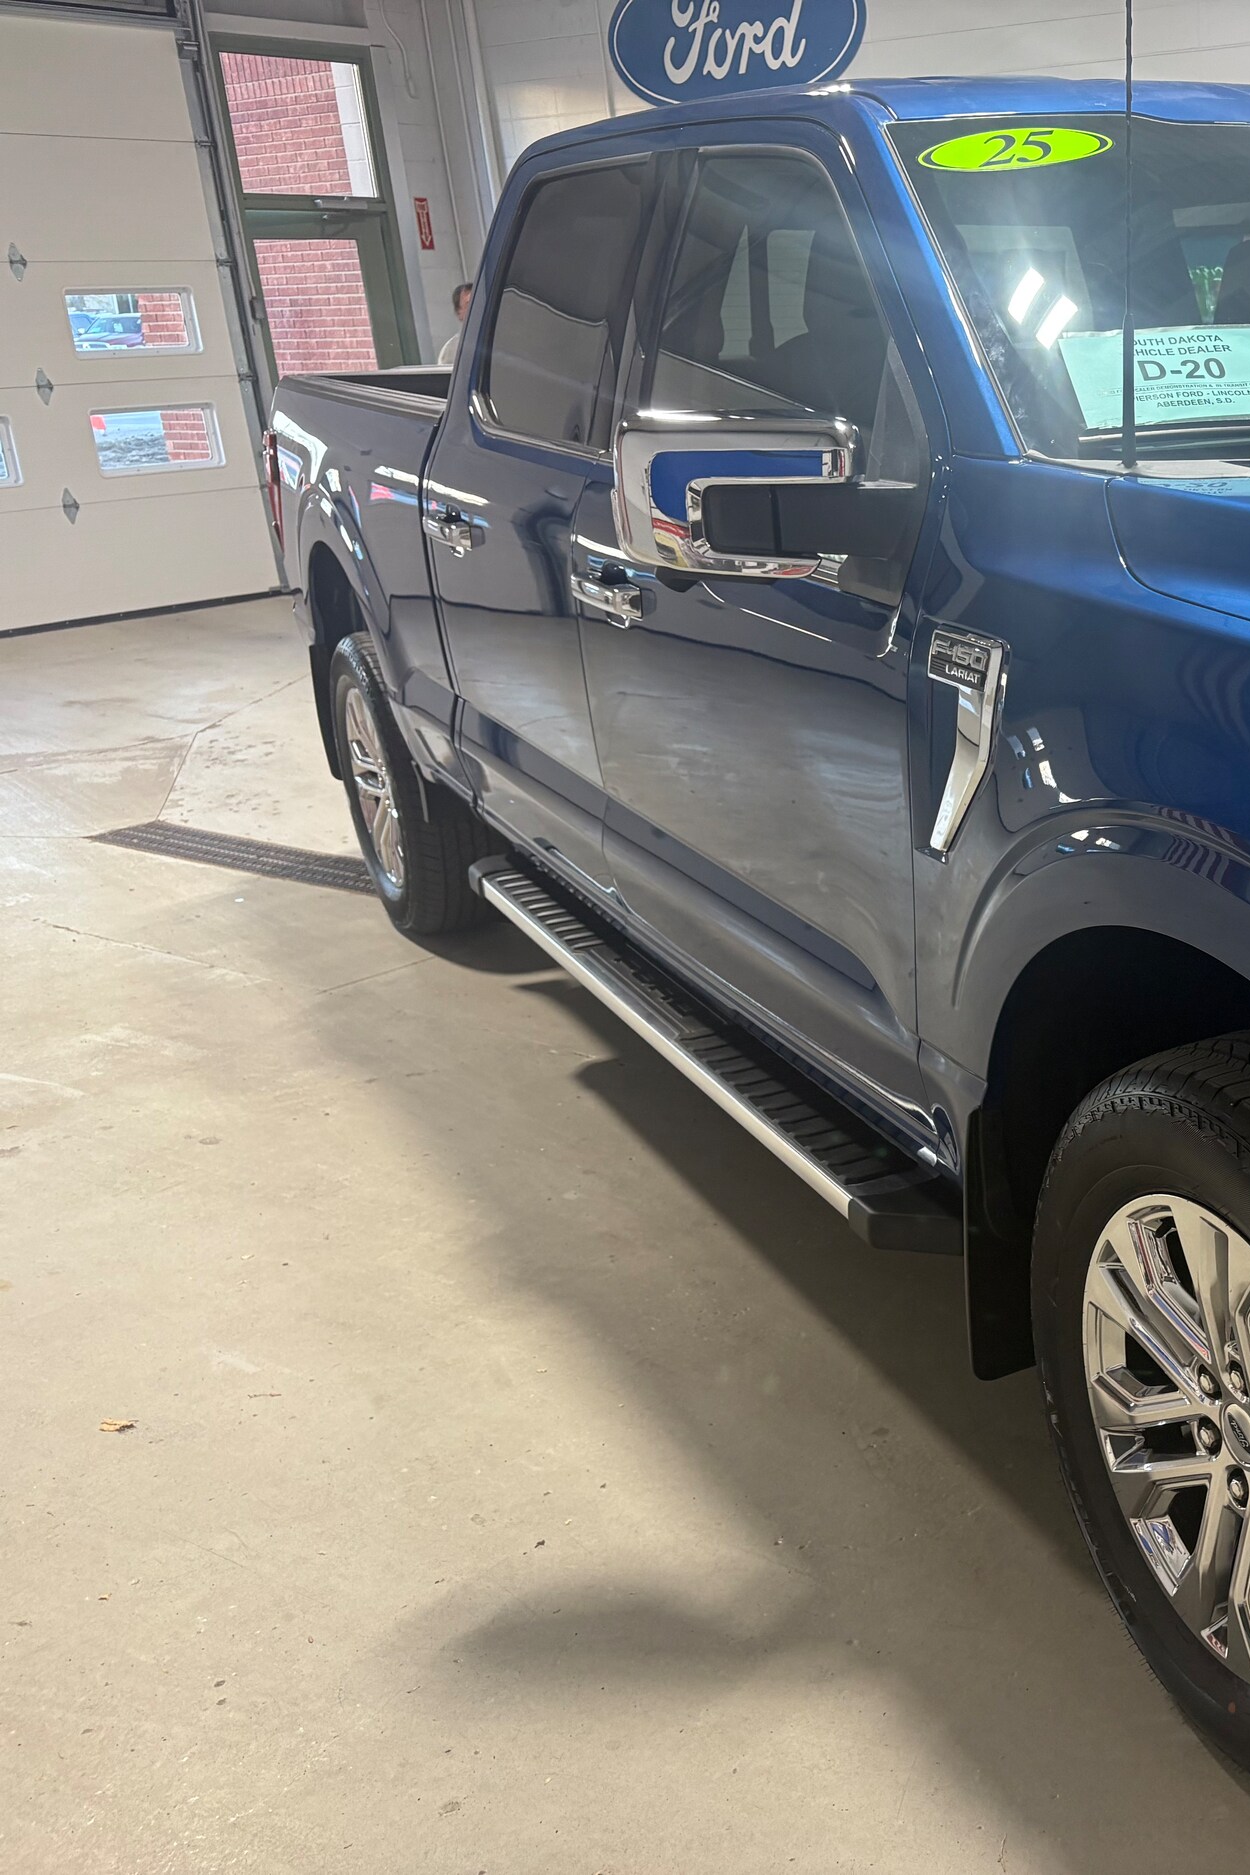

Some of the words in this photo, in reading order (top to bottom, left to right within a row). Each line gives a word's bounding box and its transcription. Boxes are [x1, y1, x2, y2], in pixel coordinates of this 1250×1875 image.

[663, 0, 807, 85] Ford
[979, 130, 1055, 168] 25
[1133, 337, 1165, 347] UTH
[1167, 334, 1223, 345] DAKOTA
[1134, 347, 1176, 357] HICLE
[1178, 344, 1232, 356] DEALER
[1136, 357, 1226, 382] D-20
[1134, 392, 1174, 402] IERSON
[1175, 390, 1204, 399] FORD
[1156, 397, 1214, 408] ABERDEEN,
[1215, 396, 1236, 405] S.D.
[945, 664, 981, 684] LARIAT
